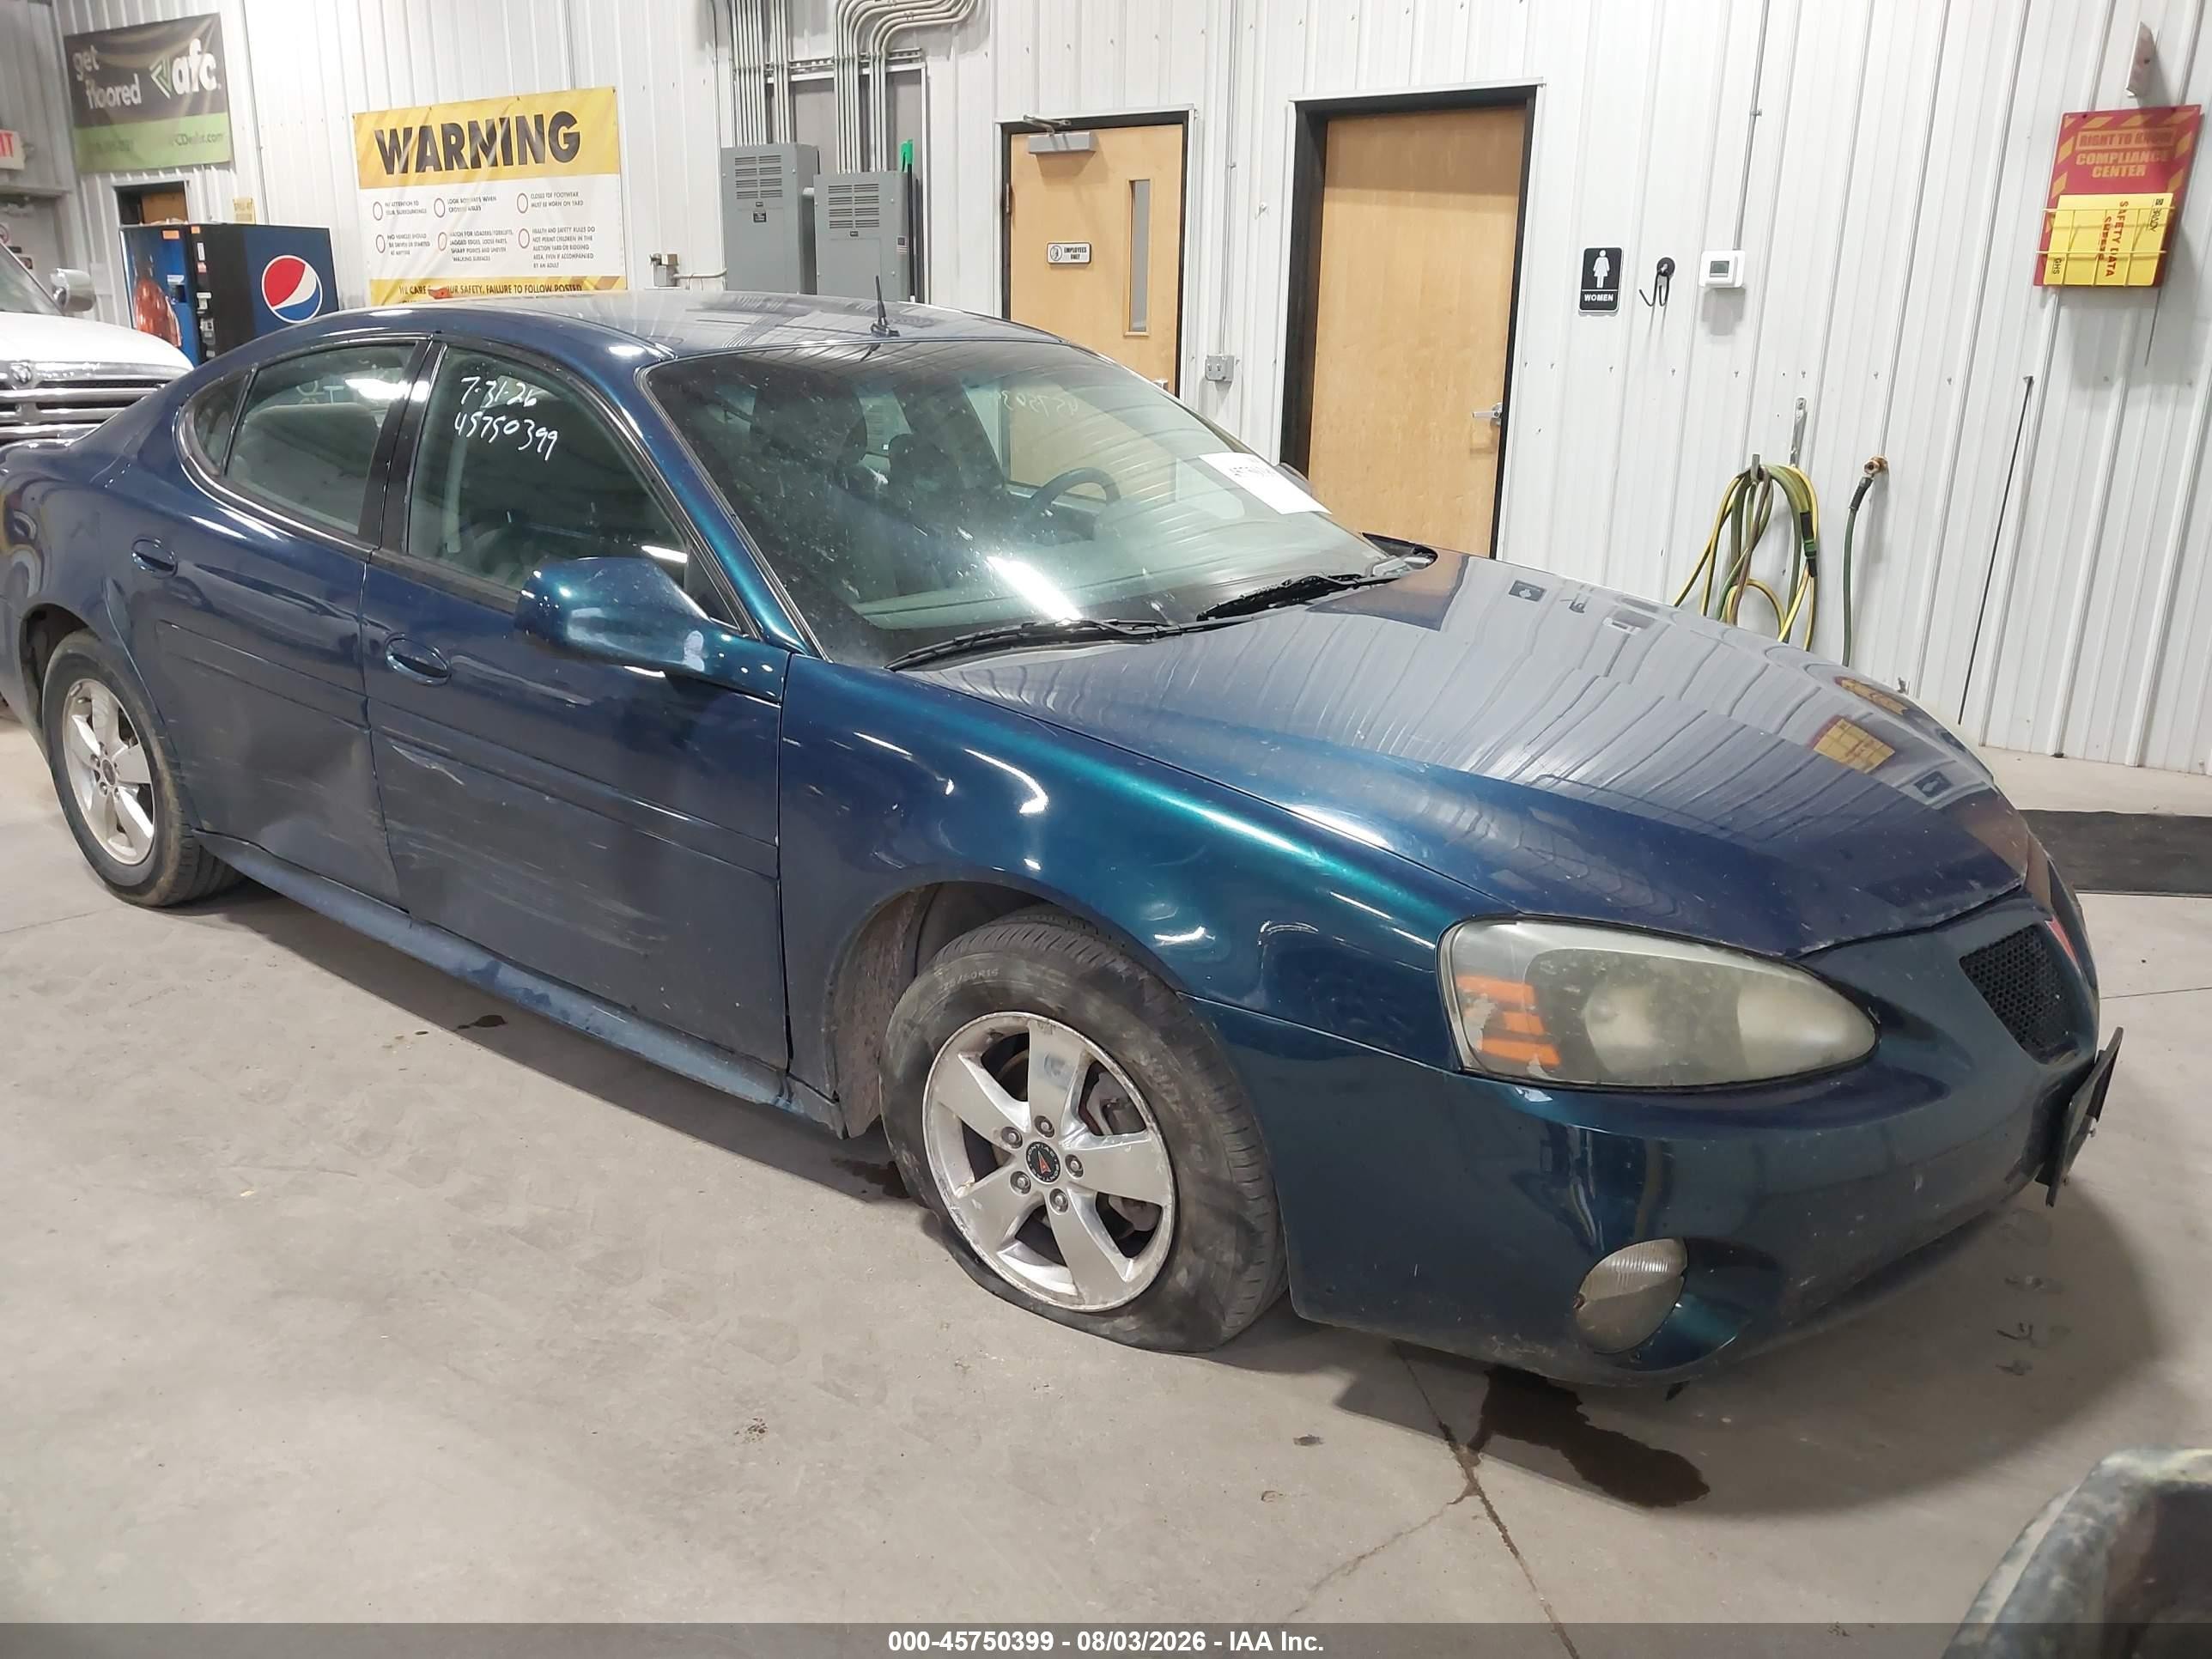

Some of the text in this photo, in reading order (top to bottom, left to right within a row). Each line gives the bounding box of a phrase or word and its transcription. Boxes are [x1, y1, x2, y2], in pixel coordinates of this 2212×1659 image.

[73, 45, 100, 82] get
[85, 73, 142, 109] floored
[0, 132, 14, 158] IT
[374, 111, 580, 175] WARNING
[2079, 133, 2116, 147] RIGHT
[2117, 132, 2131, 145] TO
[2075, 149, 2168, 165] COMPLIANCE
[2092, 164, 2147, 179] CENTER
[2112, 201, 2129, 244] SAFETY
[2149, 208, 2162, 232] BRADY
[2052, 258, 2063, 276] GHS
[409, 286, 427, 295] CARE
[486, 284, 512, 295] FAILURE
[514, 284, 523, 294] TO
[525, 283, 552, 293] FOLLOW
[1584, 294, 1613, 302] WOMEN
[454, 411, 558, 461] 45750399
